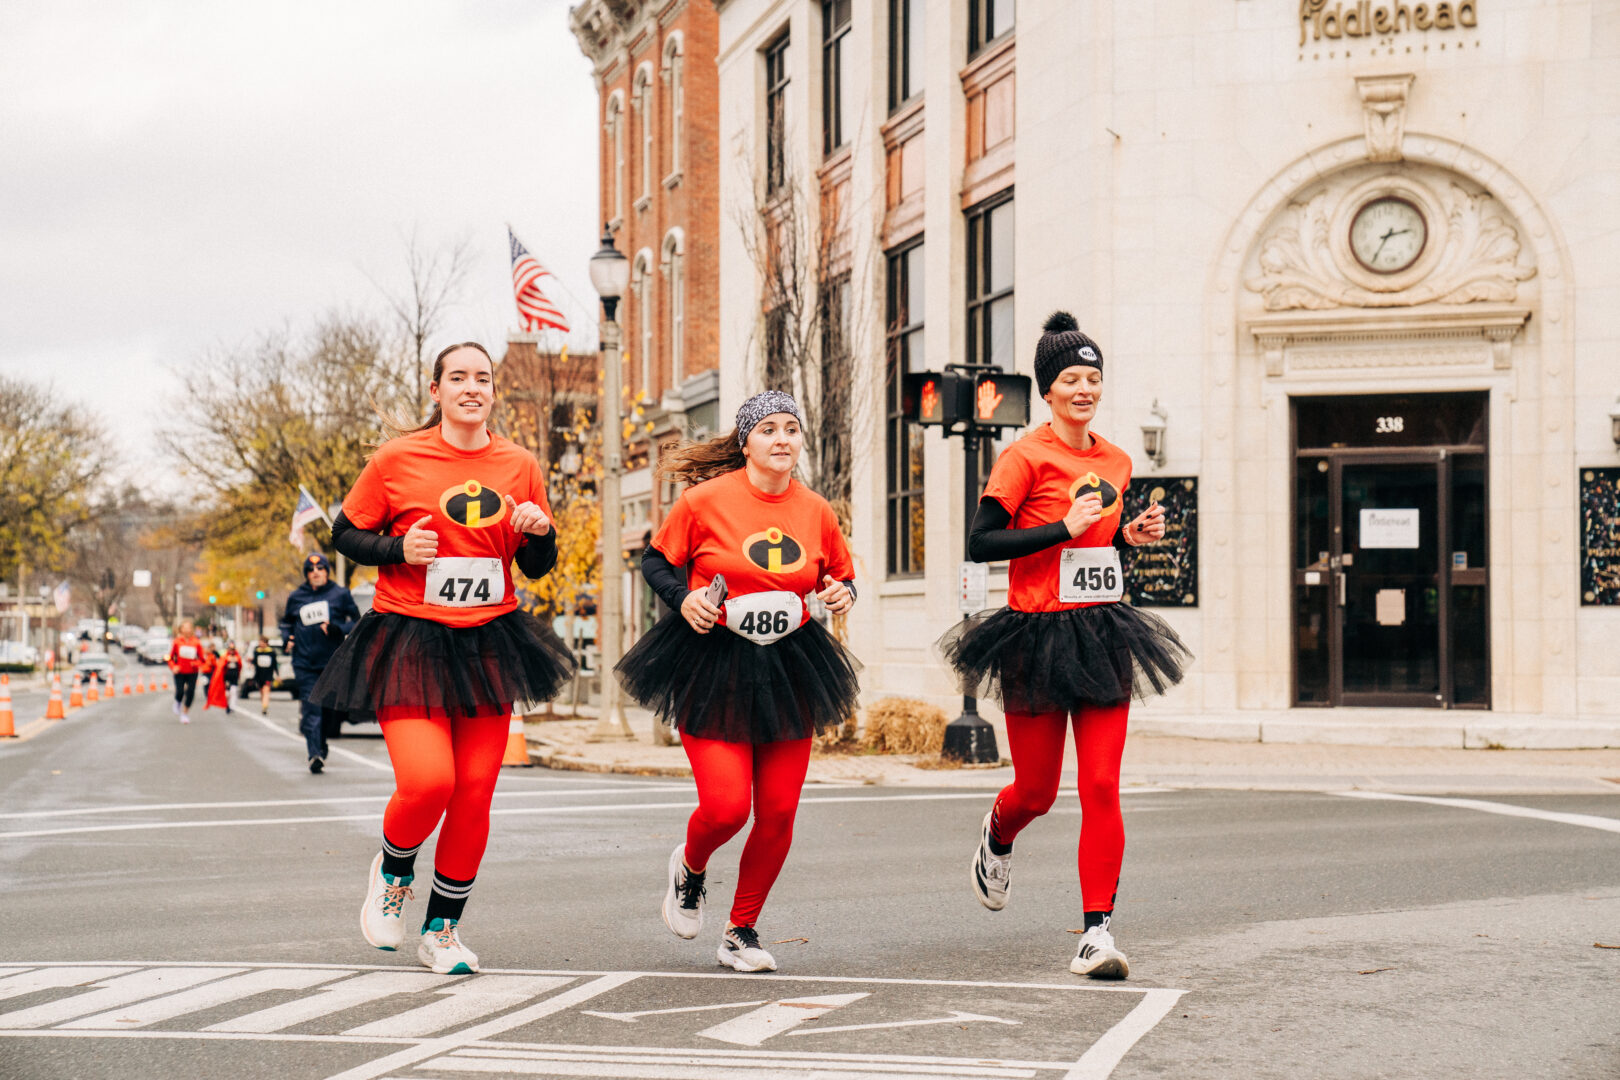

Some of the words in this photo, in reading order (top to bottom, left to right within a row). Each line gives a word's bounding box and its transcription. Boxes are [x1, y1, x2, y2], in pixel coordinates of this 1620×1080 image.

[1376, 416, 1404, 433] 338
[439, 577, 490, 602] 474
[1073, 566, 1116, 591] 456
[739, 610, 788, 635] 486
